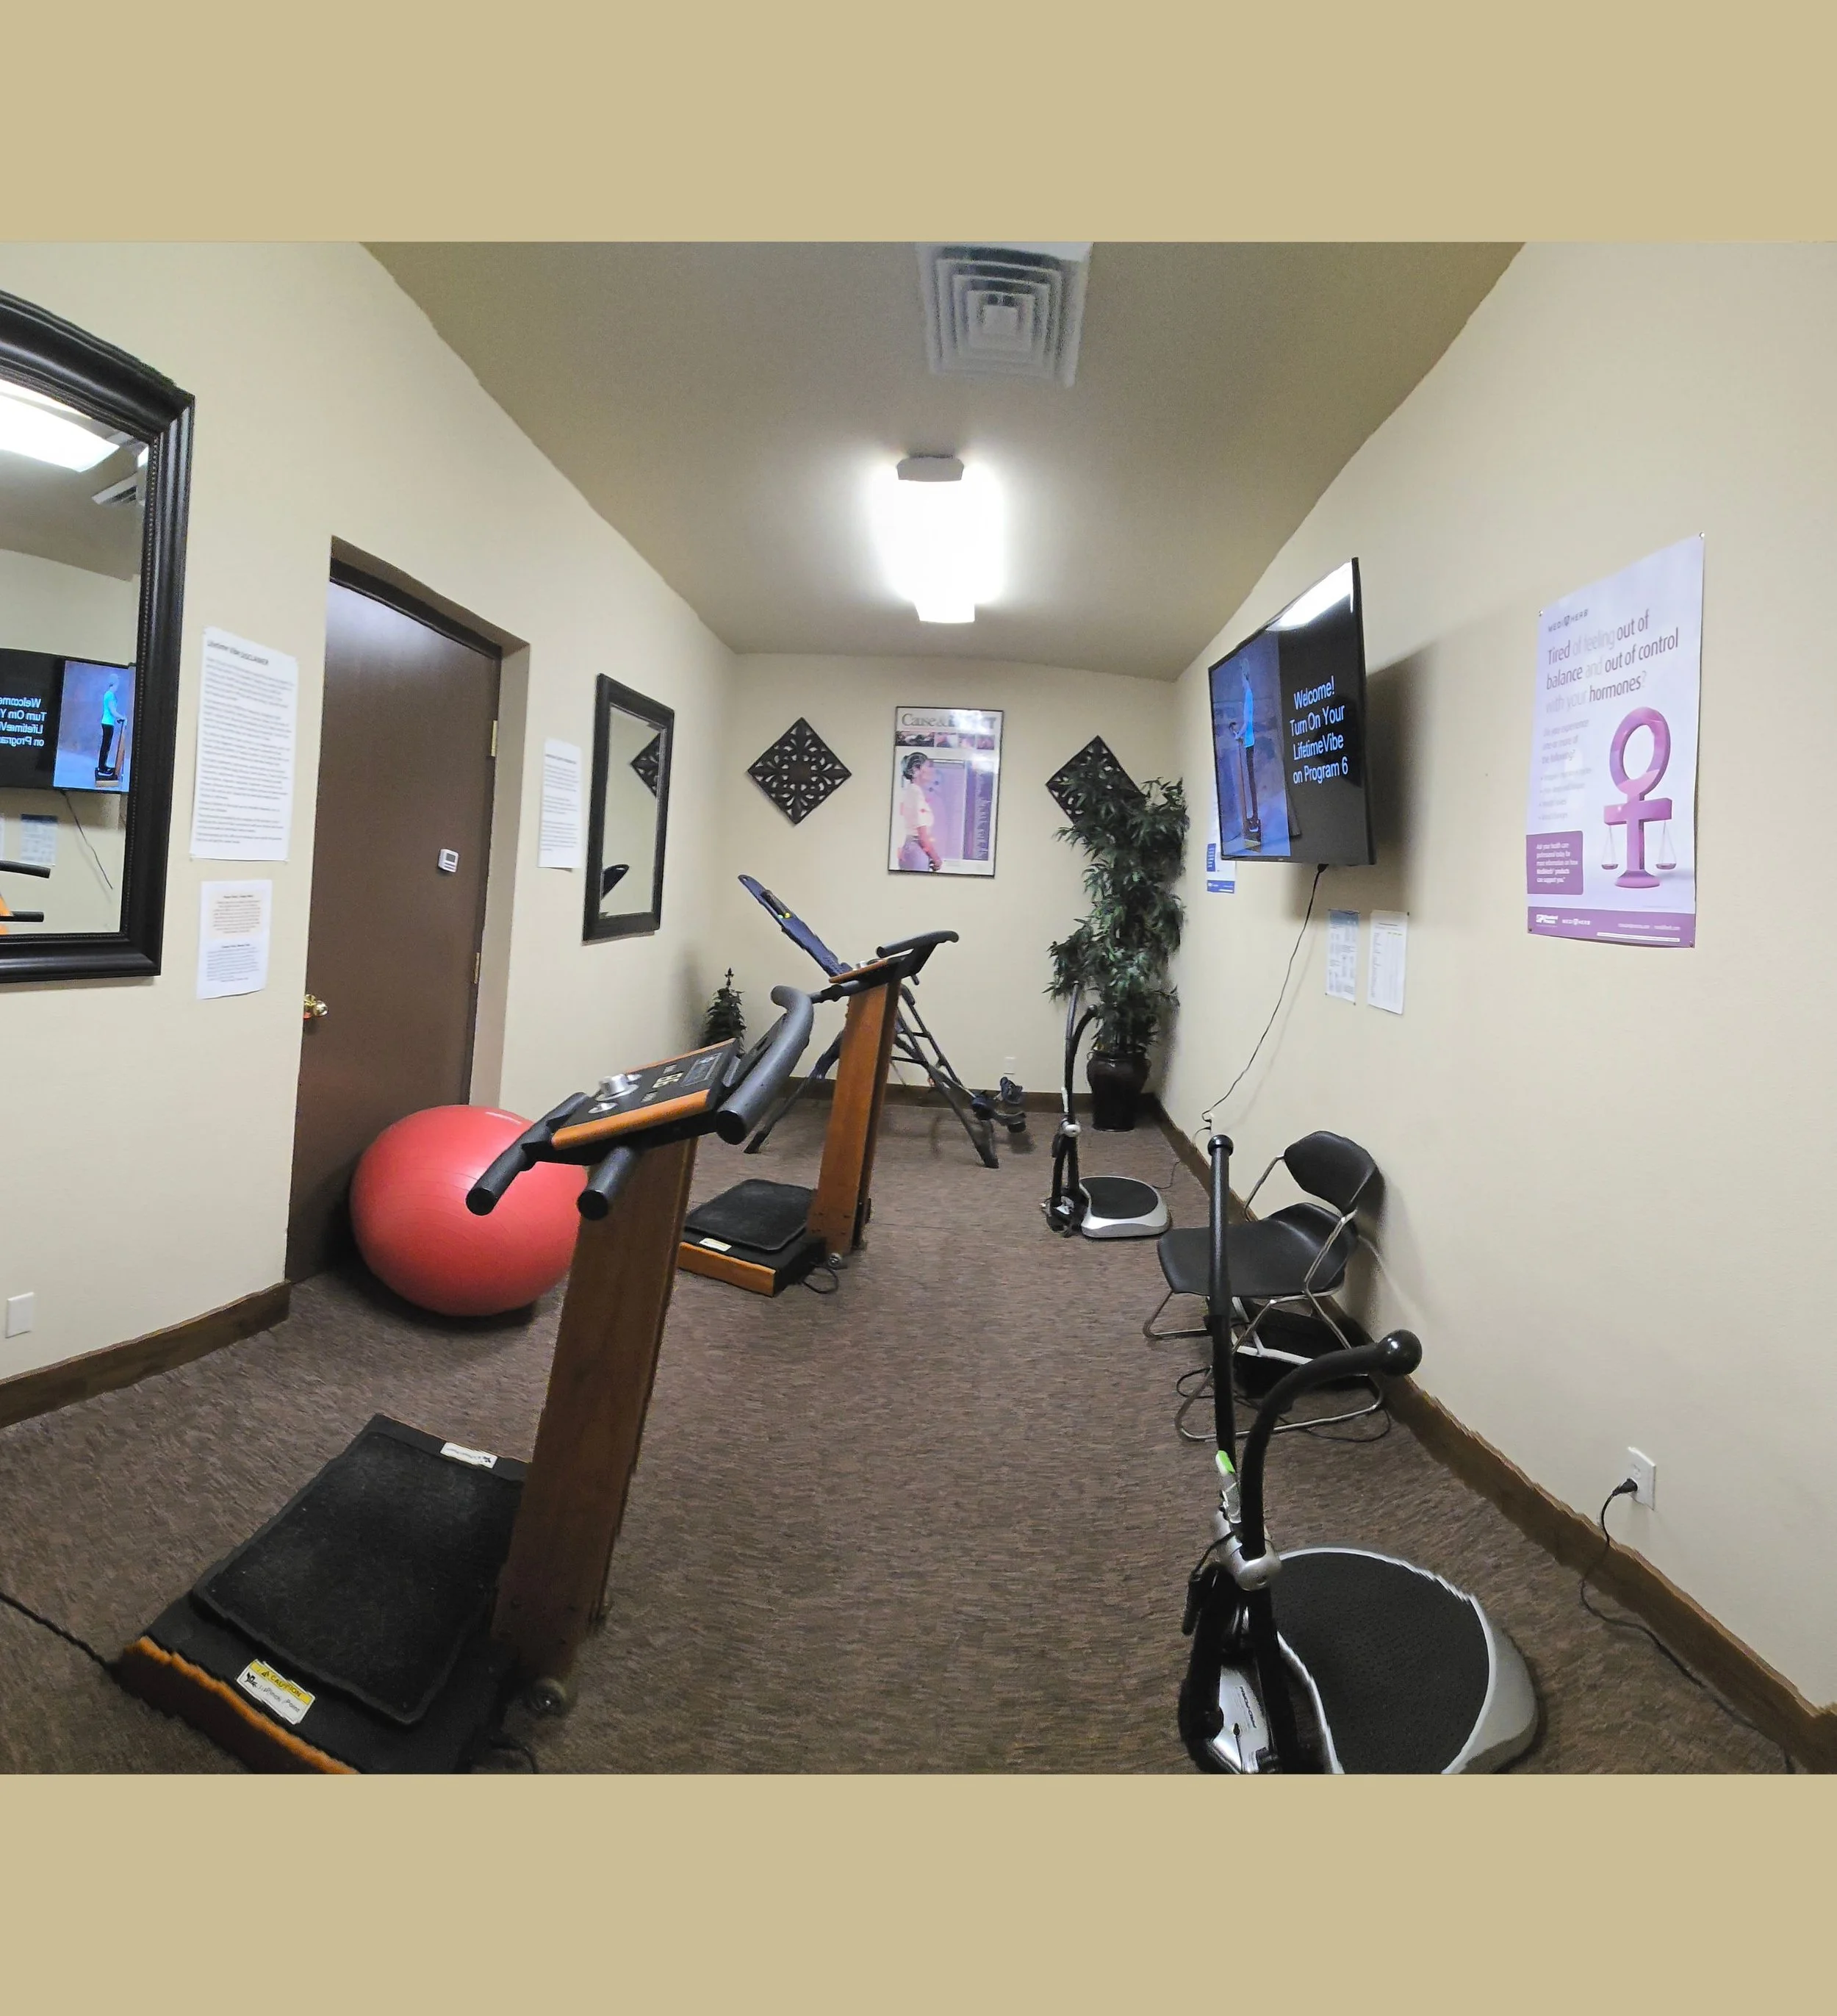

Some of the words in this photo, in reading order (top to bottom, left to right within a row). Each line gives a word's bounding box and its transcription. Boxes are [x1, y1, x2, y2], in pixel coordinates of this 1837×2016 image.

[1547, 639, 1570, 664] Tired
[1617, 619, 1635, 641] out
[1638, 609, 1650, 632] of
[1546, 666, 1583, 689] balance
[1605, 653, 1622, 672] out
[1625, 644, 1637, 666] of
[1638, 627, 1678, 660] control
[1294, 675, 1335, 710] Welcome!
[1589, 671, 1647, 702] hormones?
[1290, 720, 1307, 736] Turn
[1308, 711, 1321, 731] On
[1322, 705, 1345, 726] Your
[1293, 770, 1303, 784] on
[1304, 761, 1340, 784] Program
[1342, 756, 1348, 775] 6
[270, 1675, 302, 1697] CAUTION
